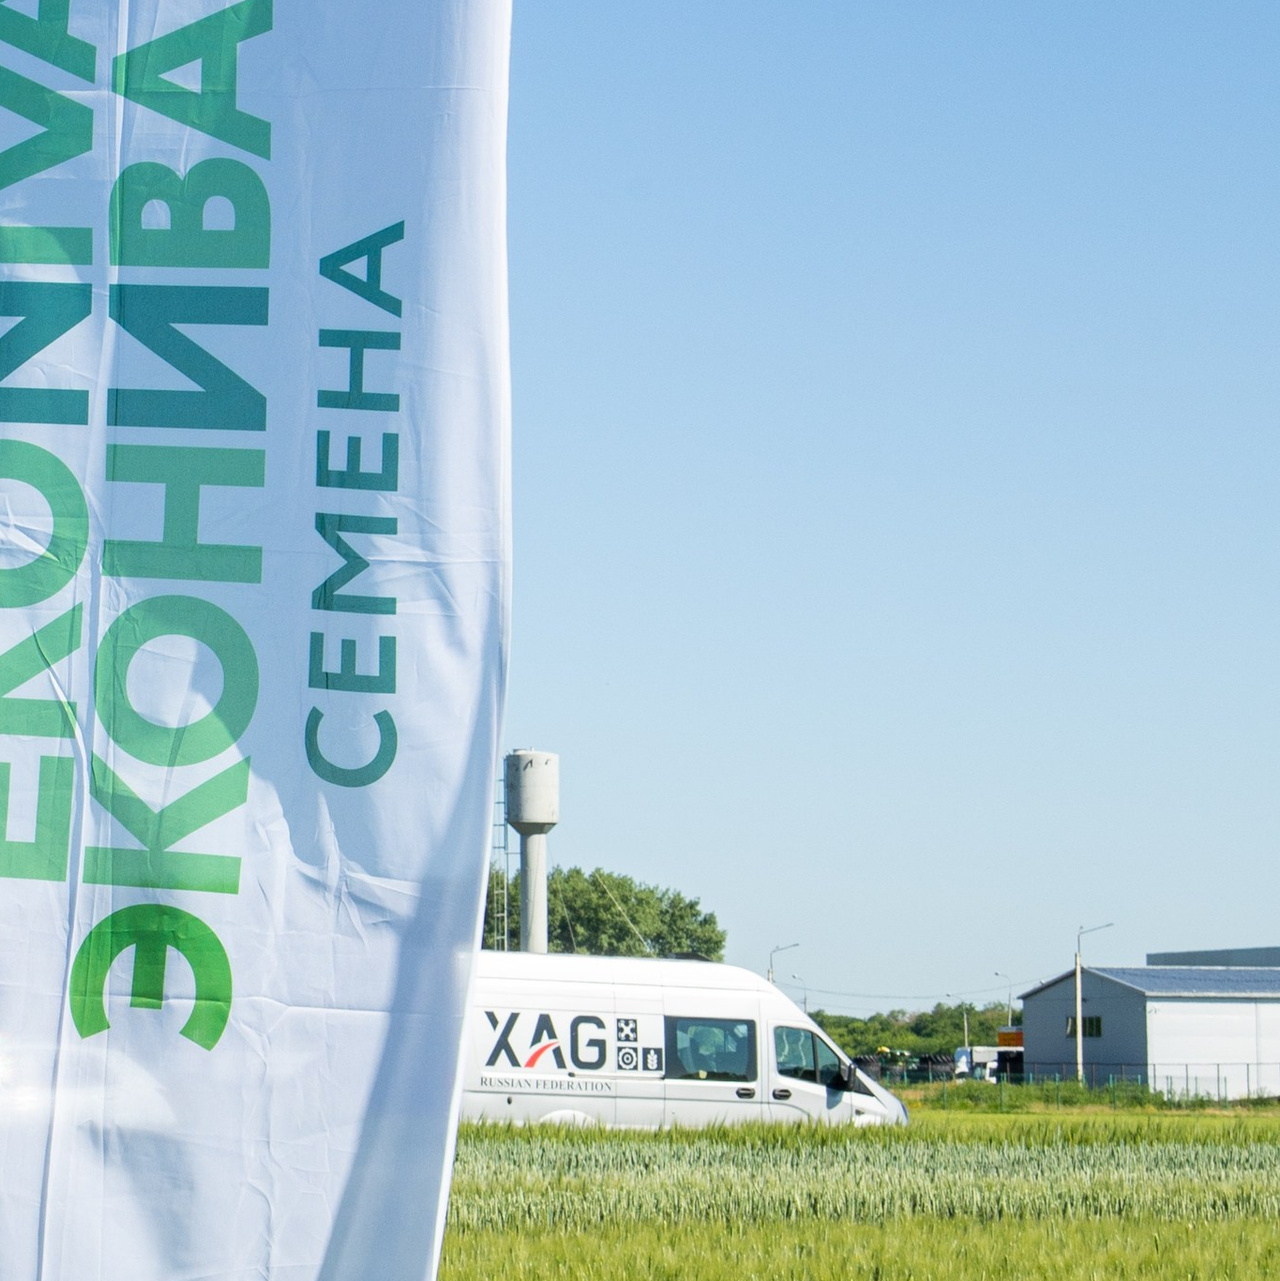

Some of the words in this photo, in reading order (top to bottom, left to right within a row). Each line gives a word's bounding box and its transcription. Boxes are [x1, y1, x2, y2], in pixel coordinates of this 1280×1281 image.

[304, 220, 406, 789] СЕМЕНА
[484, 1010, 607, 1070] XAG
[480, 1075, 532, 1090] RUSSIAN
[535, 1078, 613, 1093] FEDERATION
